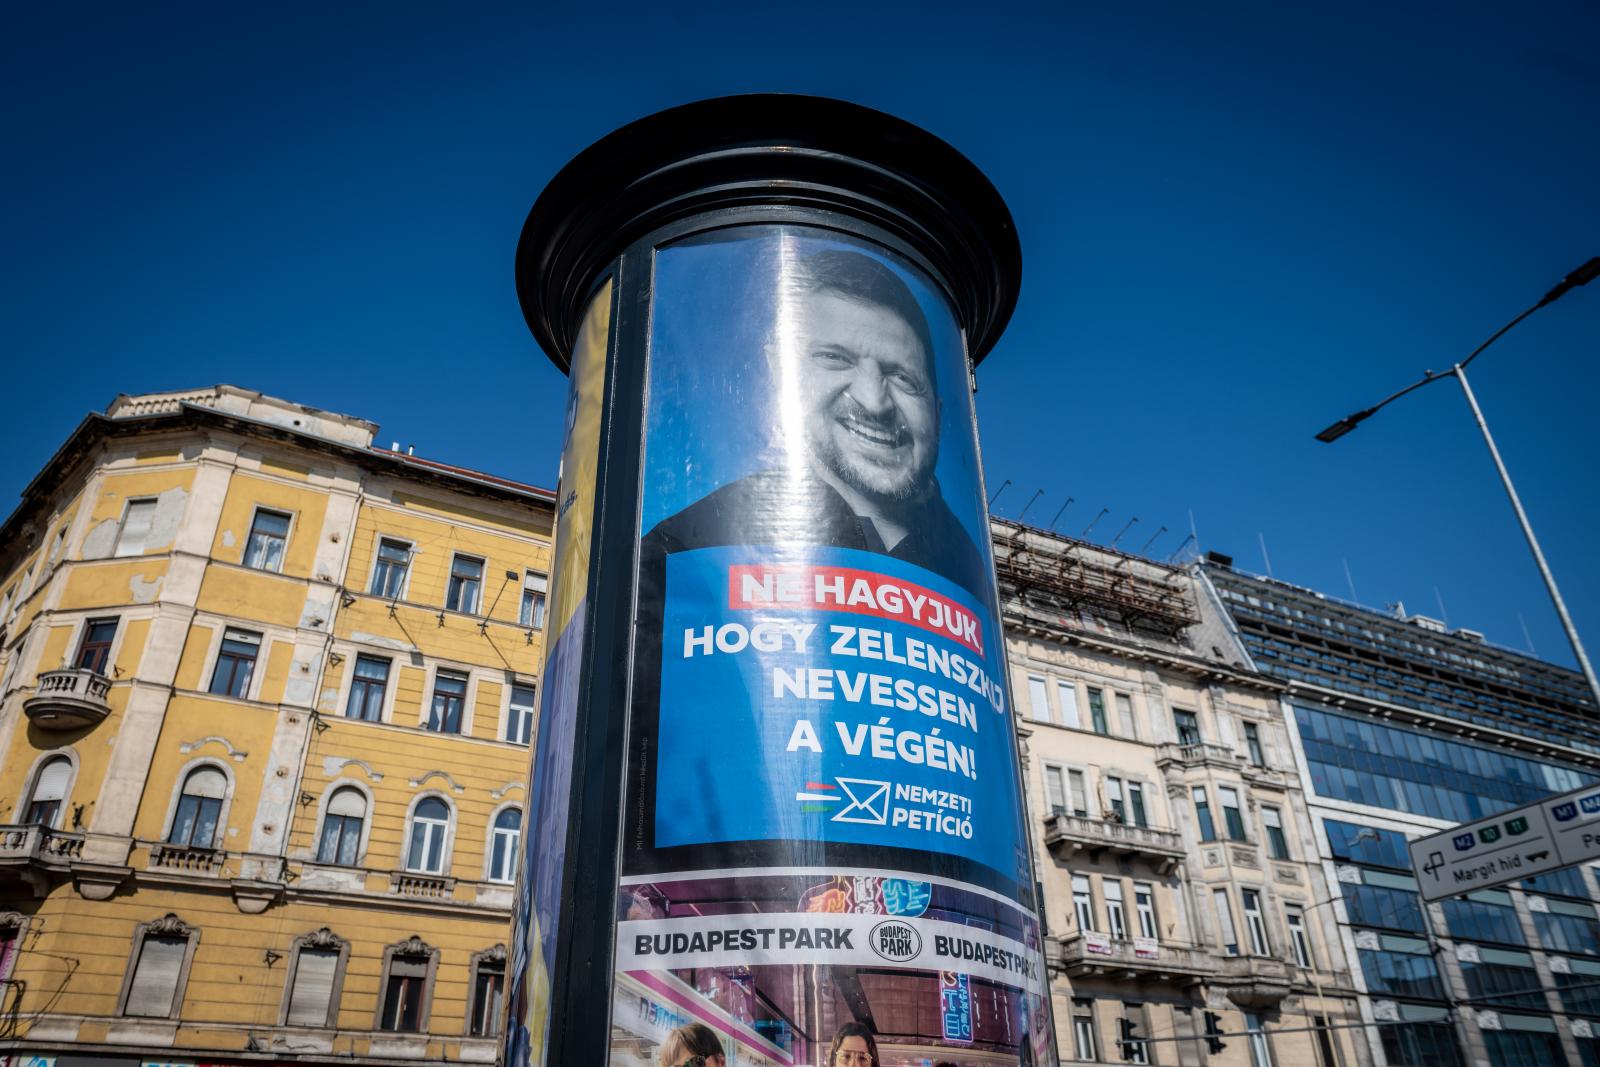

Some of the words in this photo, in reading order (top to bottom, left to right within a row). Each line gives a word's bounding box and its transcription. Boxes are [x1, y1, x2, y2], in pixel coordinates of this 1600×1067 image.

[742, 574, 802, 602] NE
[815, 574, 984, 656] HAGYJUK,
[683, 623, 818, 658] HOGY
[773, 667, 978, 733] NEVESSEN
[786, 720, 823, 753] A
[834, 717, 977, 781] VÉGÉN!
[894, 783, 972, 814] NEMZETI
[892, 806, 973, 839] PETÍCIÓ
[1455, 834, 1473, 848] M2
[1483, 828, 1497, 840] 10
[1511, 820, 1522, 833] 11
[1453, 861, 1497, 883] Margit
[635, 927, 776, 956] BUDAPEST
[778, 927, 854, 951] PARK
[880, 926, 912, 939] BUDAPEST
[880, 938, 913, 957] PARK
[934, 935, 1013, 971] BUDAPEST
[1012, 954, 1038, 981] PARK
